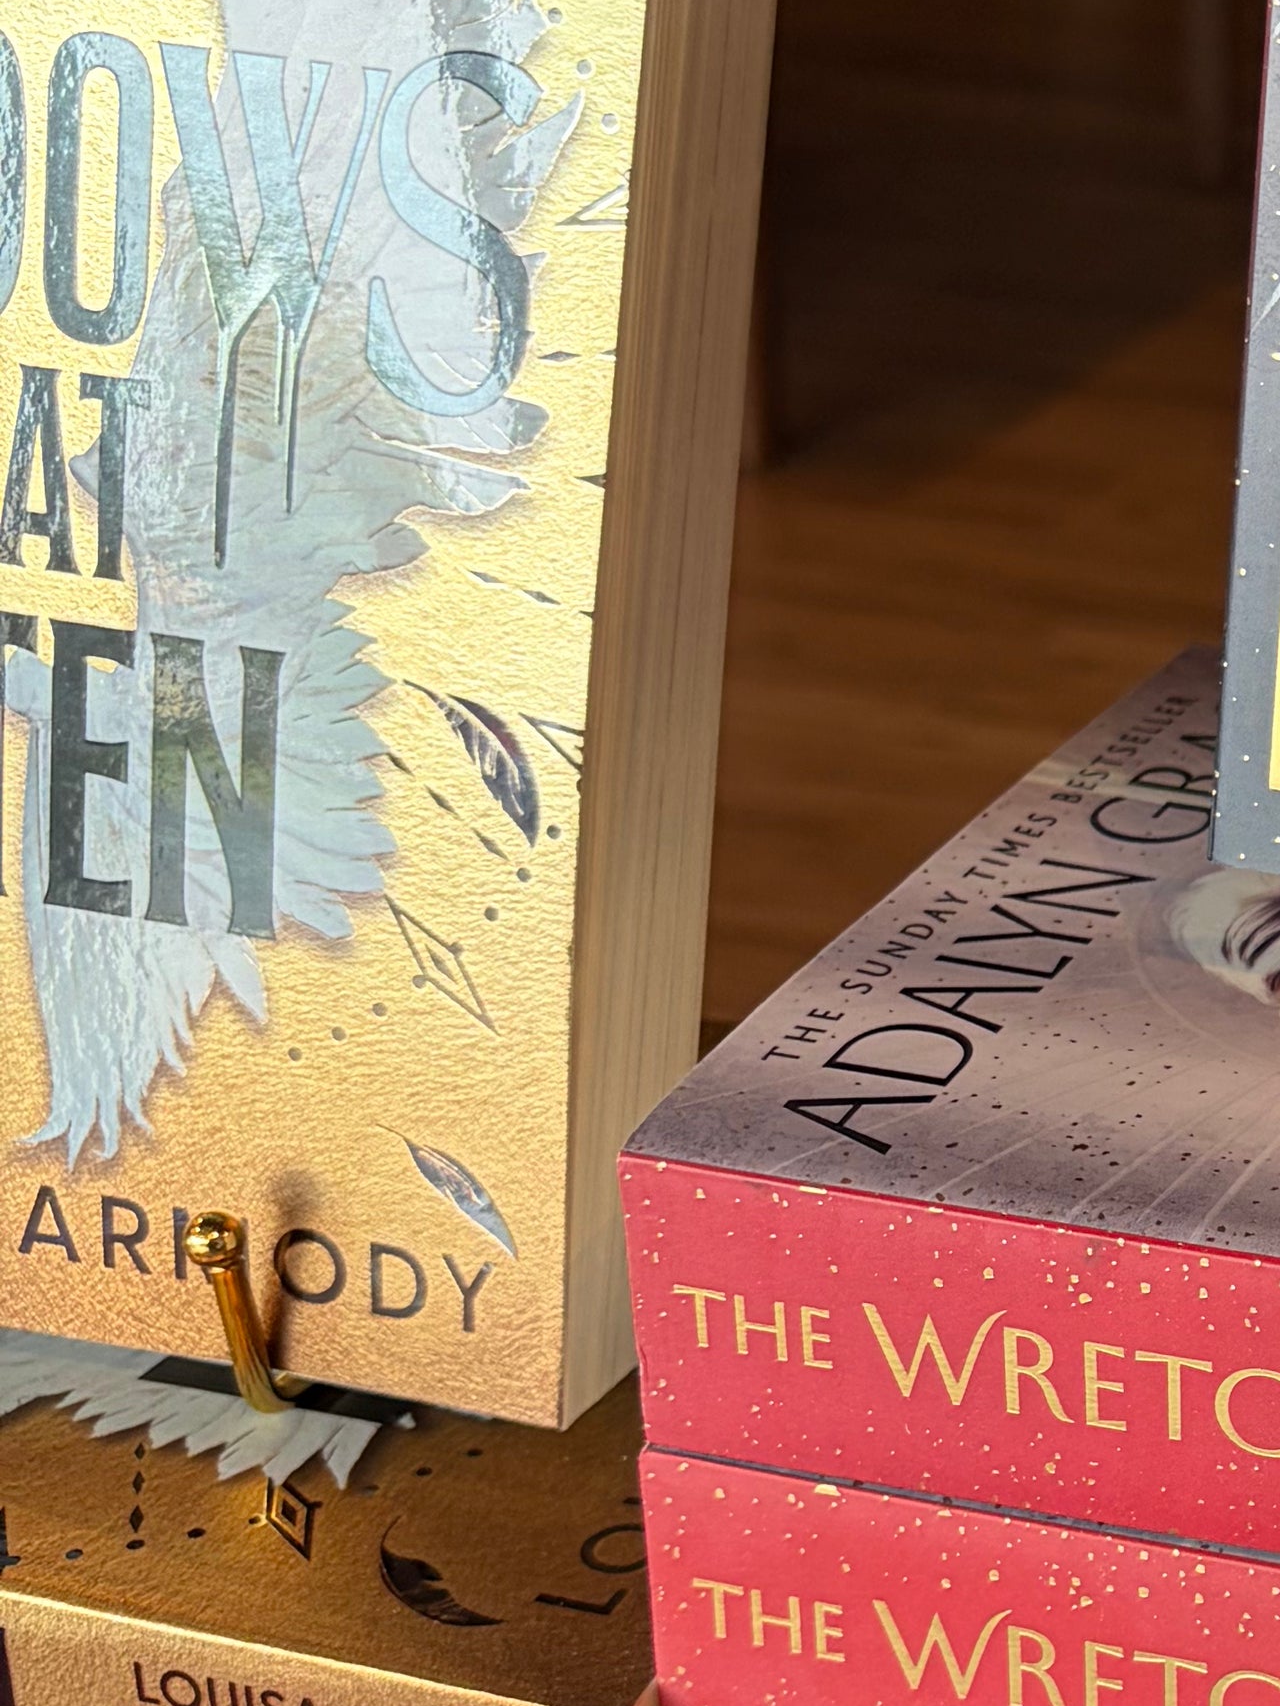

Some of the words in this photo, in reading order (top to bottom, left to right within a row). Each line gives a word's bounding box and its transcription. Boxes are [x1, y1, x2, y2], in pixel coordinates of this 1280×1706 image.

[760, 1004, 845, 1065] THE
[840, 888, 970, 998] SUNDAY
[963, 809, 1059, 882] TIMES
[1050, 696, 1200, 805] BESTSELLER
[783, 858, 1157, 1156] ADALYN
[19, 1185, 494, 1332] ARODY
[673, 1284, 833, 1369] THE
[691, 1577, 845, 1664] THE
